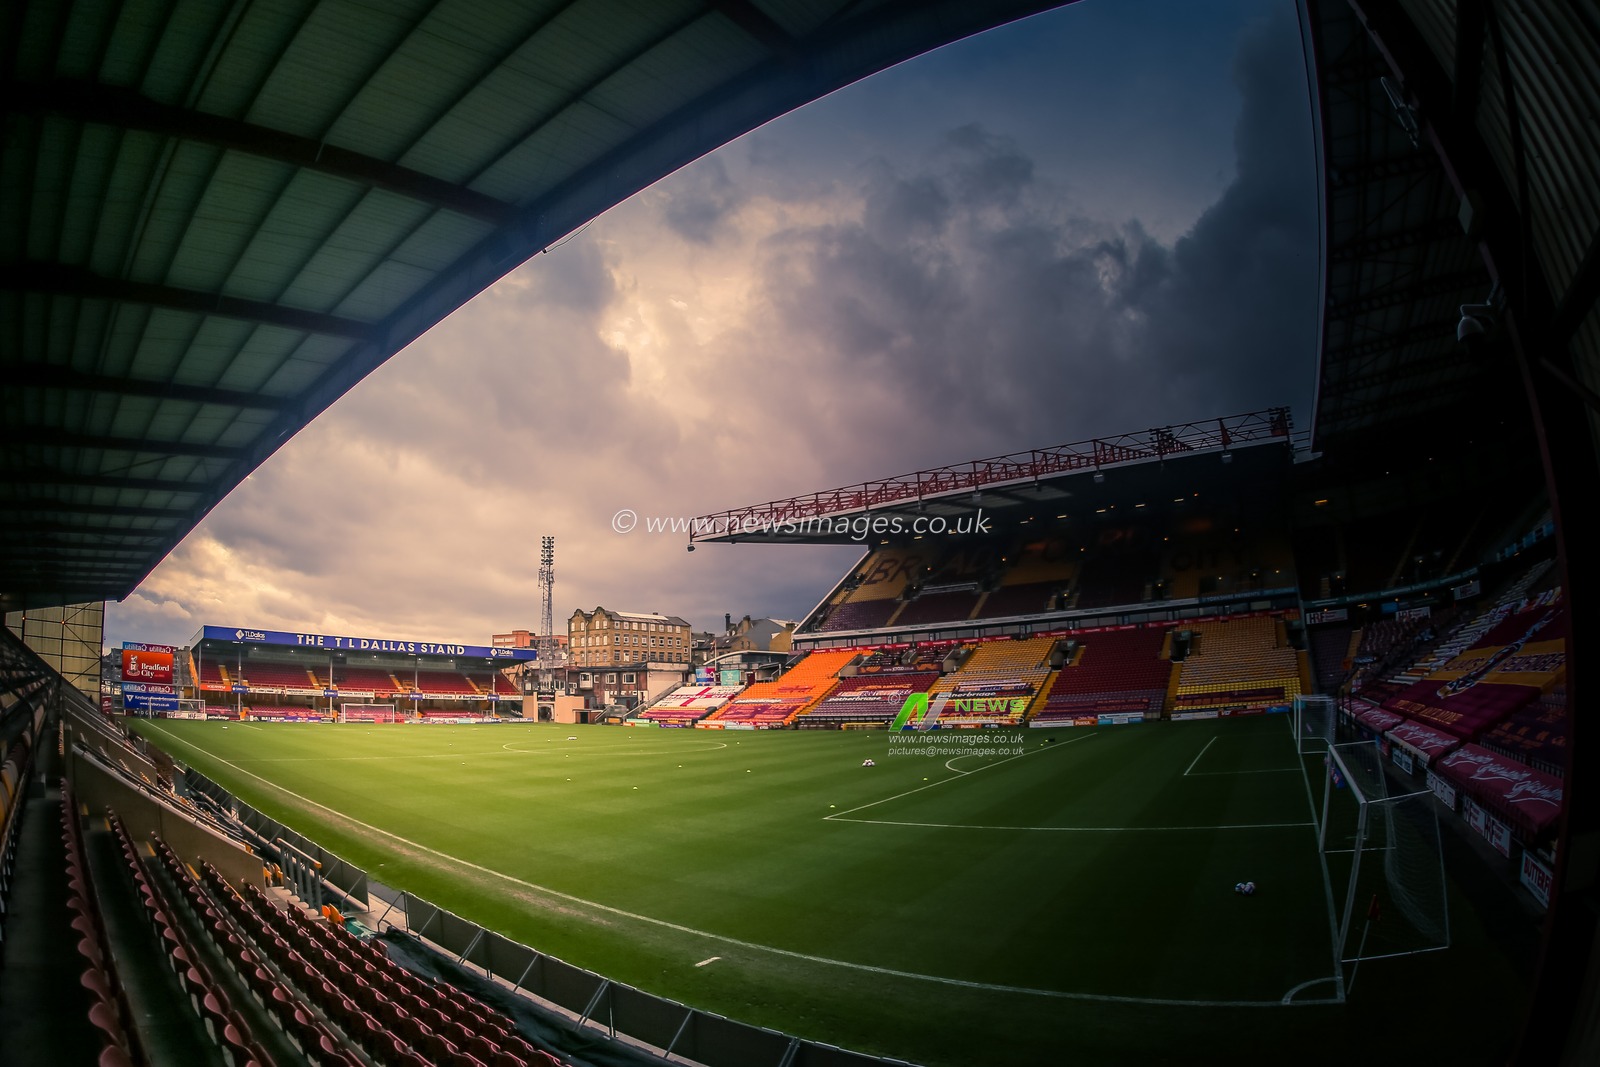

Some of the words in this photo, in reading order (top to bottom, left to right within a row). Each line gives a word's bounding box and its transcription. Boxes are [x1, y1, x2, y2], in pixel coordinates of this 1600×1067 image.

[296, 634, 324, 646] THE
[335, 637, 342, 648] T
[348, 638, 355, 649] L
[360, 639, 415, 653] DALLAS
[420, 643, 465, 656] STAND
[141, 662, 170, 672] Bradford
[141, 670, 155, 679] City
